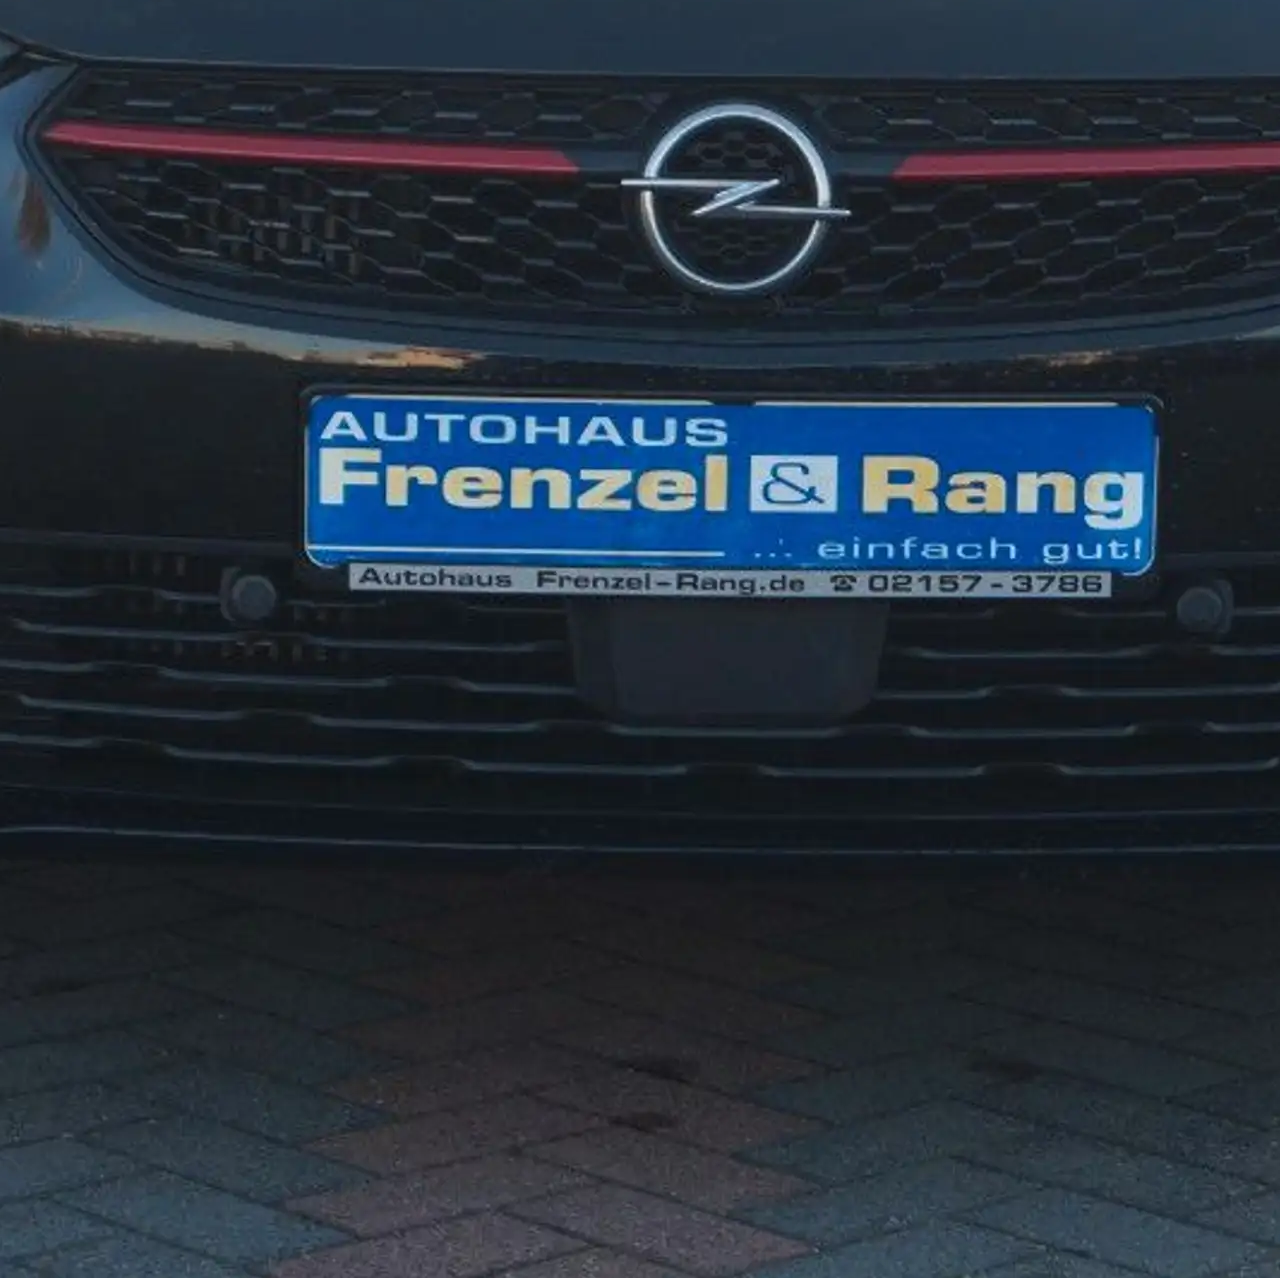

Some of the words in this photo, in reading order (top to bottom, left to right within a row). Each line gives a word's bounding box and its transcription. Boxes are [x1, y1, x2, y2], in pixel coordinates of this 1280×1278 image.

[321, 411, 728, 447] AUTOHAUS
[320, 447, 728, 512] Frenzel
[760, 460, 827, 507] &
[862, 455, 1144, 530] Rang
[817, 537, 1016, 560] einfach
[1042, 538, 1142, 565] gut!
[358, 567, 513, 589] Autohaus
[536, 569, 805, 596] Frenzel-Rang.de
